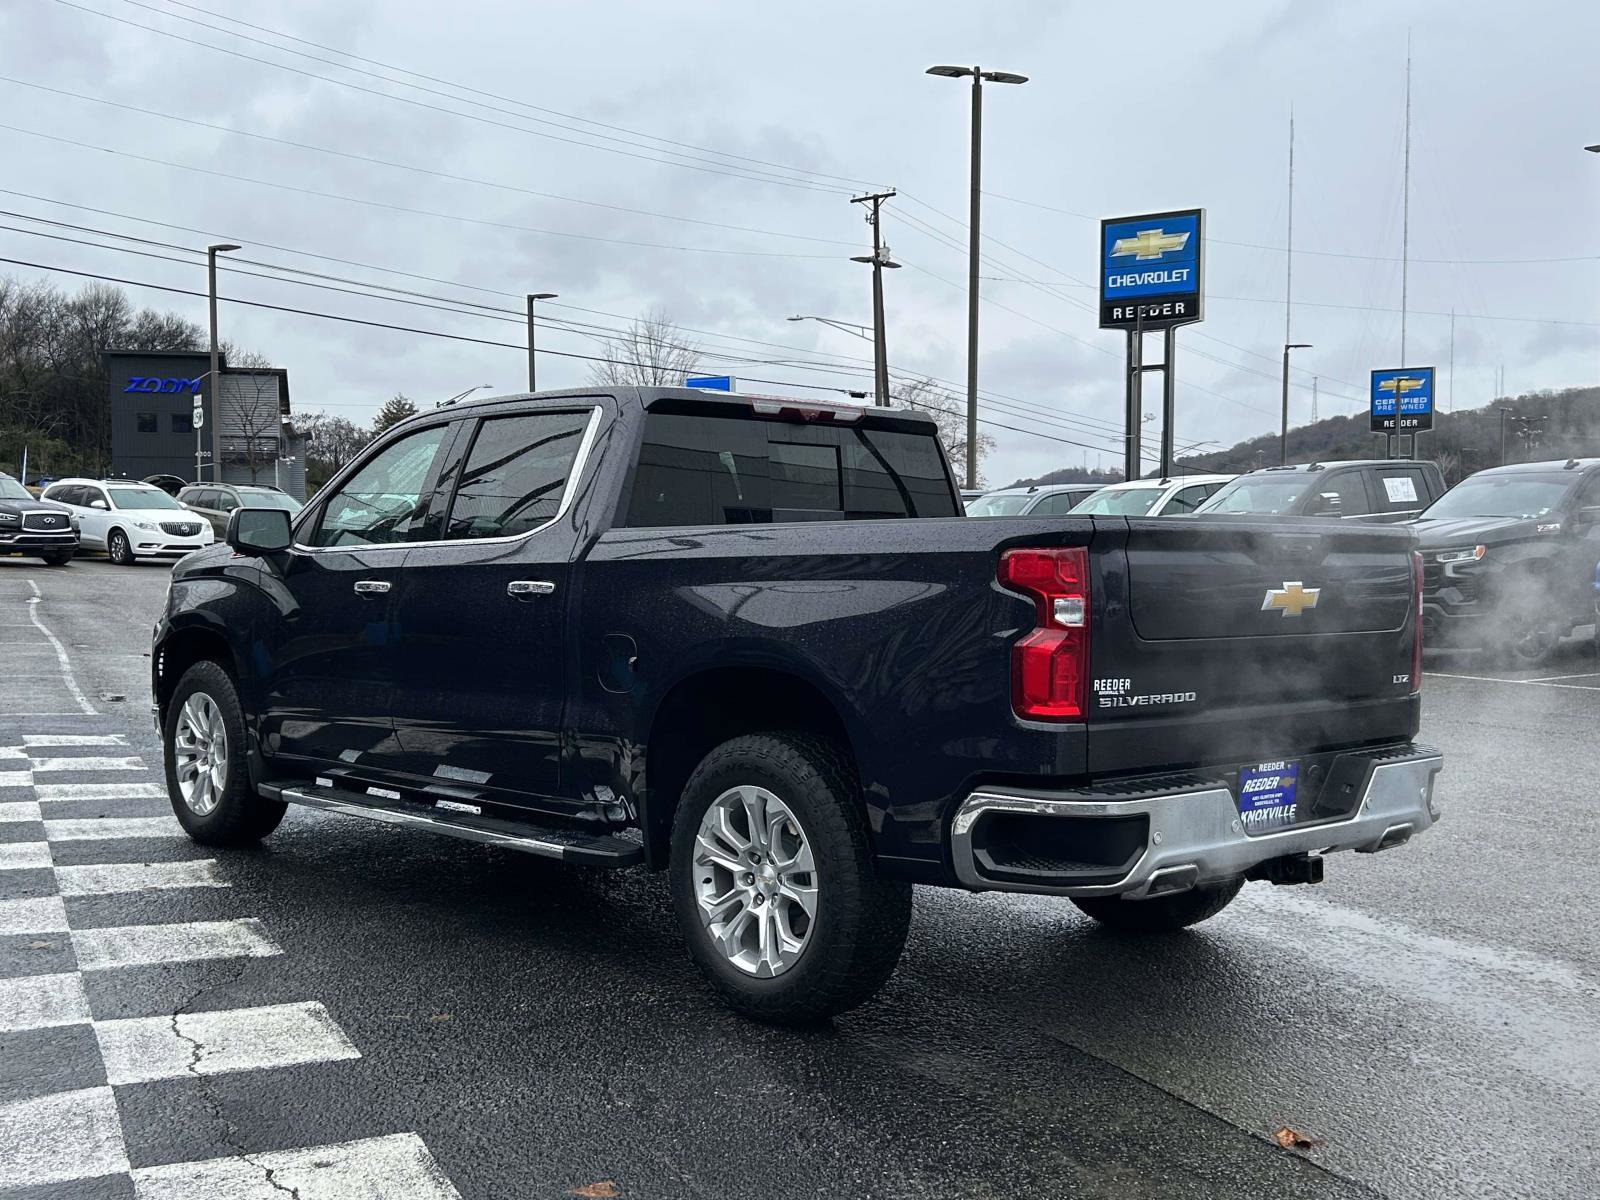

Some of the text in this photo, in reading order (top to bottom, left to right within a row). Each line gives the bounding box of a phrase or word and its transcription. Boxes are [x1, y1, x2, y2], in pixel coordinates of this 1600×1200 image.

[1108, 269, 1190, 288] CHEVROLET
[123, 377, 201, 393] ZOOM
[1375, 397, 1427, 406] CERIFIED
[1384, 419, 1418, 428] REDER
[1094, 679, 1131, 691] REEDER
[1393, 675, 1409, 684] LTZ
[1099, 692, 1196, 708] SILVERADO
[1259, 761, 1285, 772] REEDER
[1242, 776, 1280, 793] REEDER
[1241, 804, 1297, 823] KNOXVILLE
